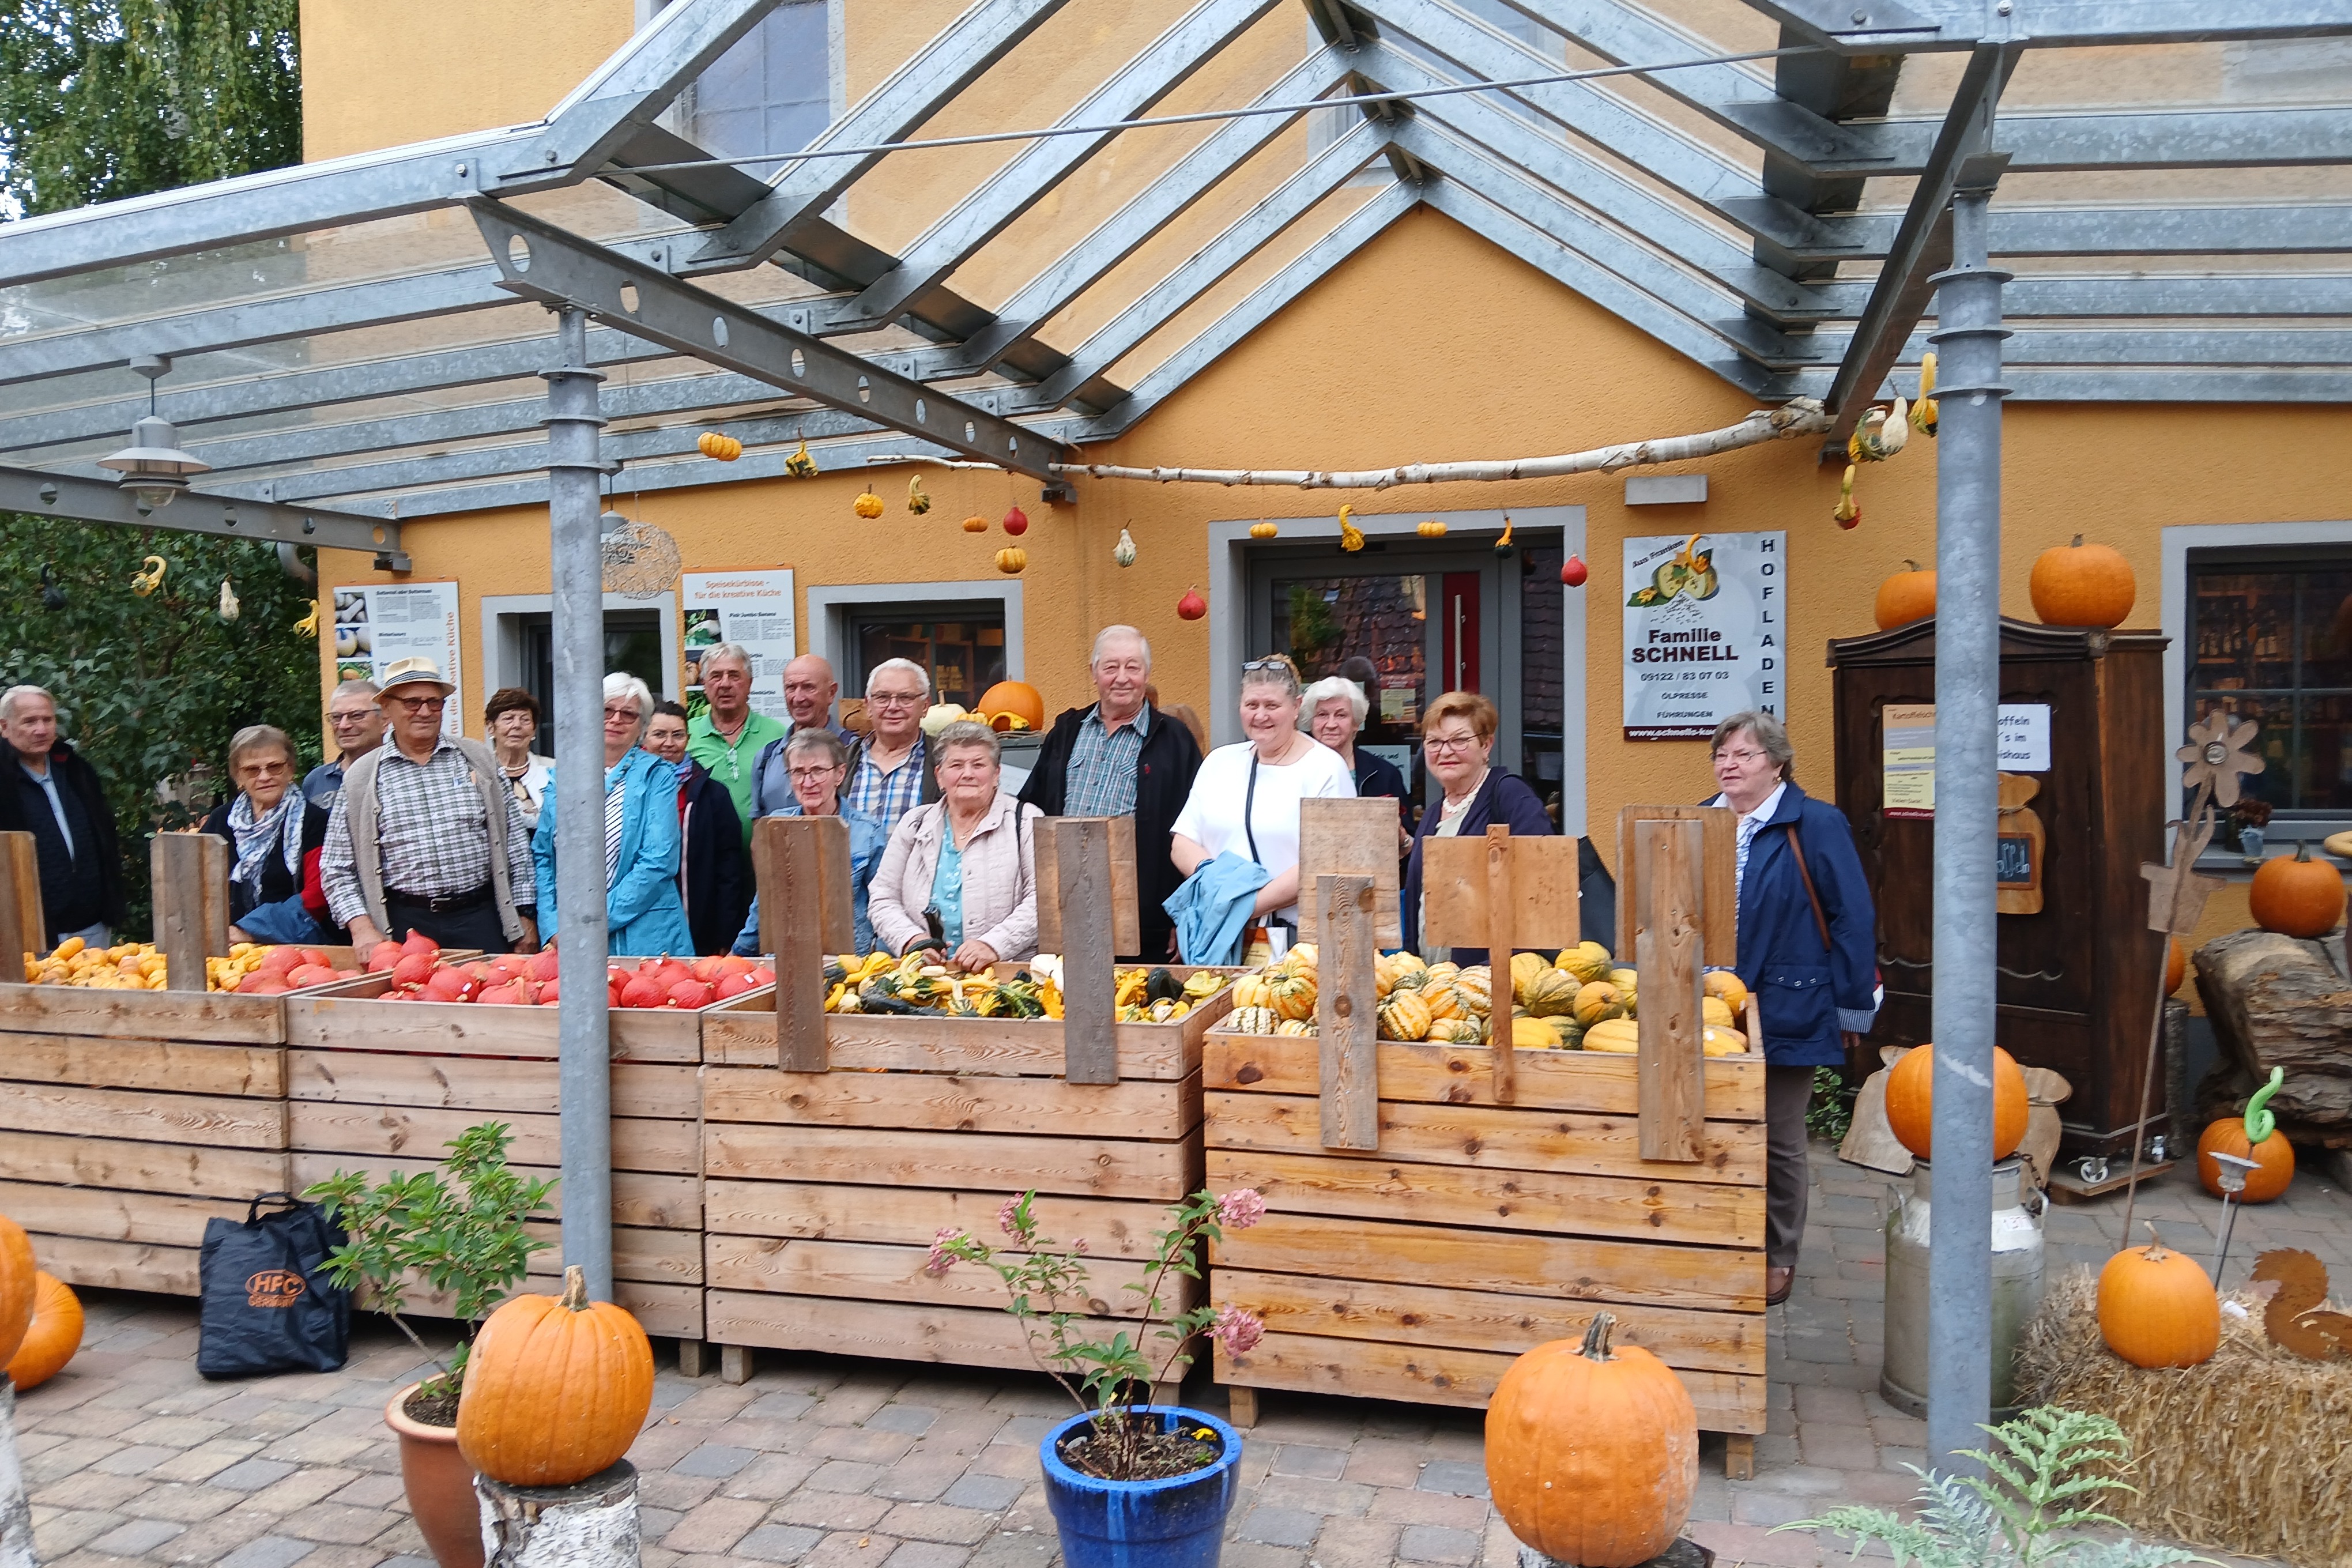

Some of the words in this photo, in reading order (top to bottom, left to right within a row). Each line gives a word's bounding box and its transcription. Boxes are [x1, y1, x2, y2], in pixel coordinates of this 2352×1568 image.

[1633, 557, 1649, 568] Aus
[1649, 540, 1686, 559] Franken
[722, 590, 755, 598] kreative
[756, 589, 781, 597] Küche
[446, 612, 455, 646] Küche
[1649, 628, 1722, 643] Familie
[1632, 644, 1739, 663] SCHNELL
[1641, 672, 1674, 681] 09122
[1682, 672, 1696, 681] 83
[1699, 672, 1713, 680] 07
[1715, 671, 1729, 680] 03
[1661, 691, 1708, 700] ÖLPRESSE
[448, 698, 458, 715] die
[1657, 710, 1713, 719] FÜHRUNGEN
[1997, 715, 2030, 726] offeln
[2015, 732, 2026, 742] im
[1998, 749, 2030, 759] ishaus
[1997, 843, 2030, 878] offeln
[253, 1275, 300, 1295] HFC
